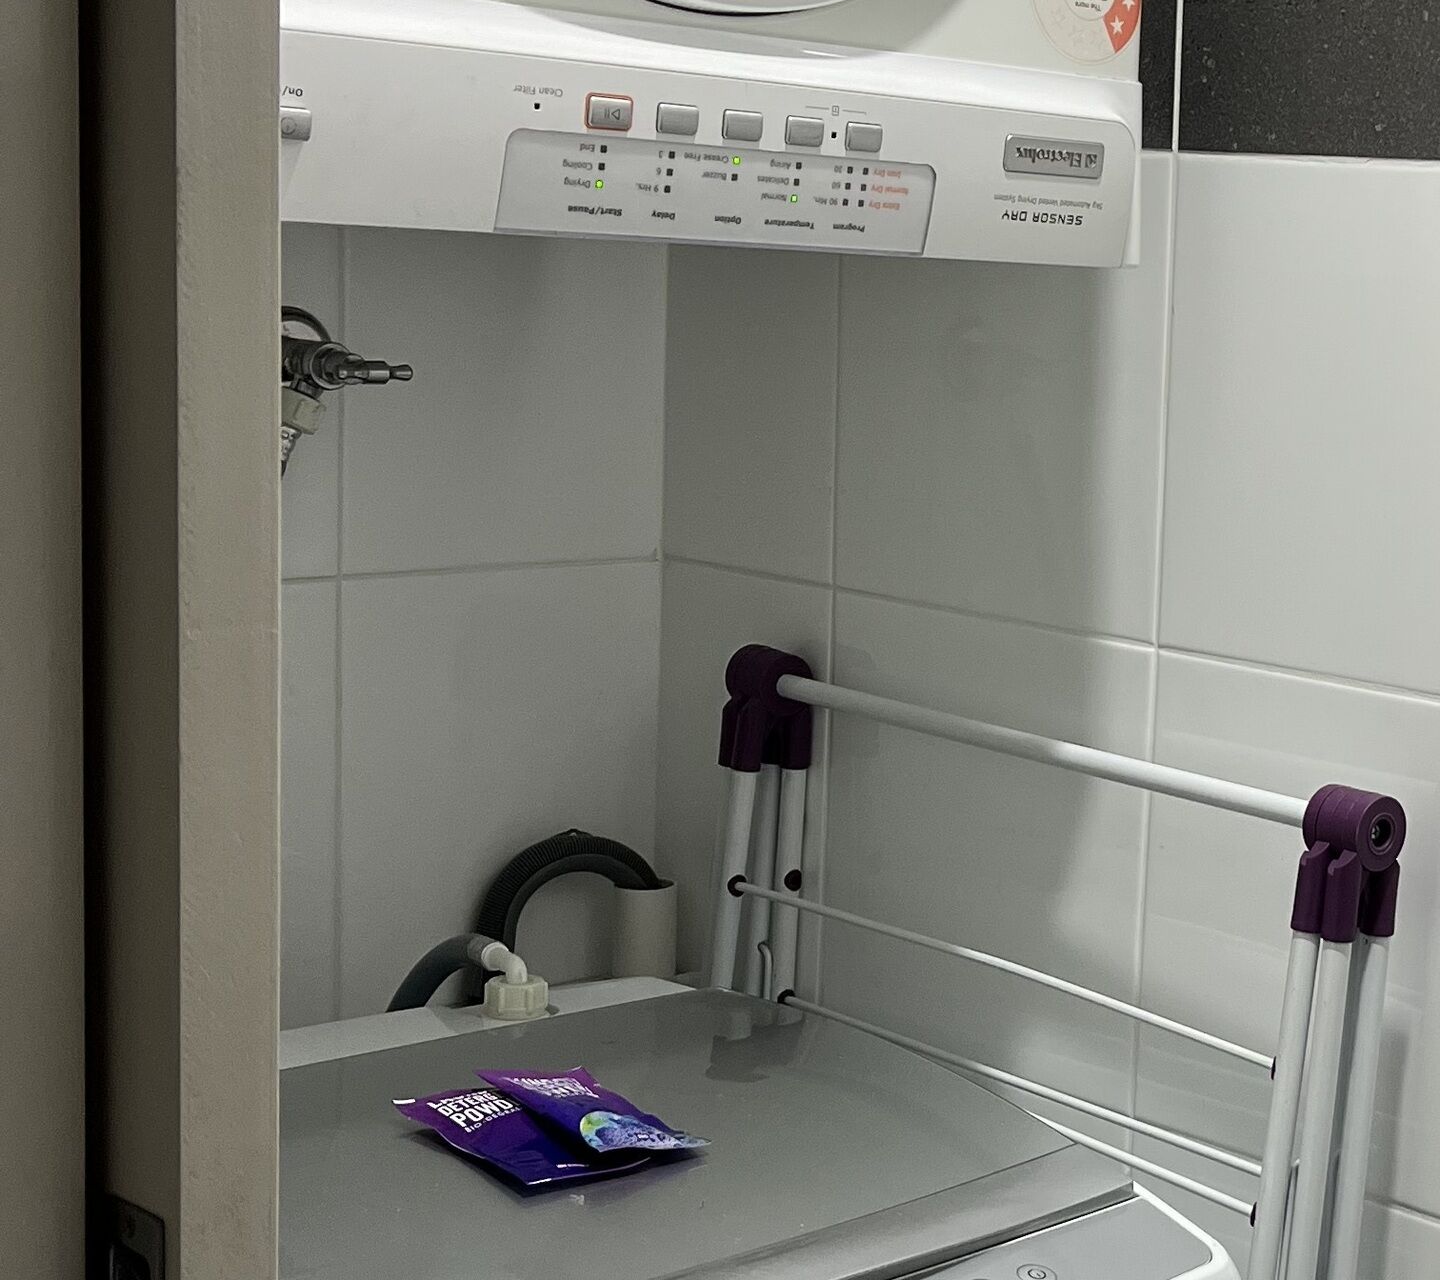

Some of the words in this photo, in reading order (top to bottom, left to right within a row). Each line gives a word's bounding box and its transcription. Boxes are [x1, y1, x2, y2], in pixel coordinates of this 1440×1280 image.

[1075, 1, 1090, 9] more
[1091, 3, 1101, 12] The
[281, 86, 303, 98] On/
[513, 85, 536, 95] Filter
[539, 87, 563, 98] Clean
[580, 144, 595, 152] End
[684, 152, 701, 161] Free
[703, 154, 729, 163] Crease
[1016, 147, 1082, 168] Electrolux
[562, 159, 593, 170] Cooling
[770, 159, 791, 170] Airing
[656, 167, 662, 175] 6
[702, 171, 728, 180] Buzzer
[874, 170, 885, 178] Dry
[563, 177, 591, 188] Drying
[757, 175, 790, 186] Delicates
[831, 181, 841, 190] 60
[636, 183, 652, 192] Hrs.
[654, 185, 660, 193] 9
[871, 185, 883, 193] Dry
[761, 192, 788, 202] Normal
[829, 198, 838, 206] 90
[994, 194, 1016, 203] System
[1018, 195, 1038, 205] Drying
[868, 201, 880, 209] Dry
[1038, 198, 1058, 207] Vented
[1060, 200, 1091, 209] Automated
[567, 205, 623, 217] Start/Pause
[651, 210, 676, 220] Delay
[1001, 210, 1028, 222] DRY
[714, 215, 742, 225] Option
[1032, 212, 1083, 226] SENSOR
[764, 219, 815, 230] Temperature
[832, 223, 865, 233] Program
[437, 1091, 501, 1117] DETERG
[449, 1100, 518, 1128] POWD
